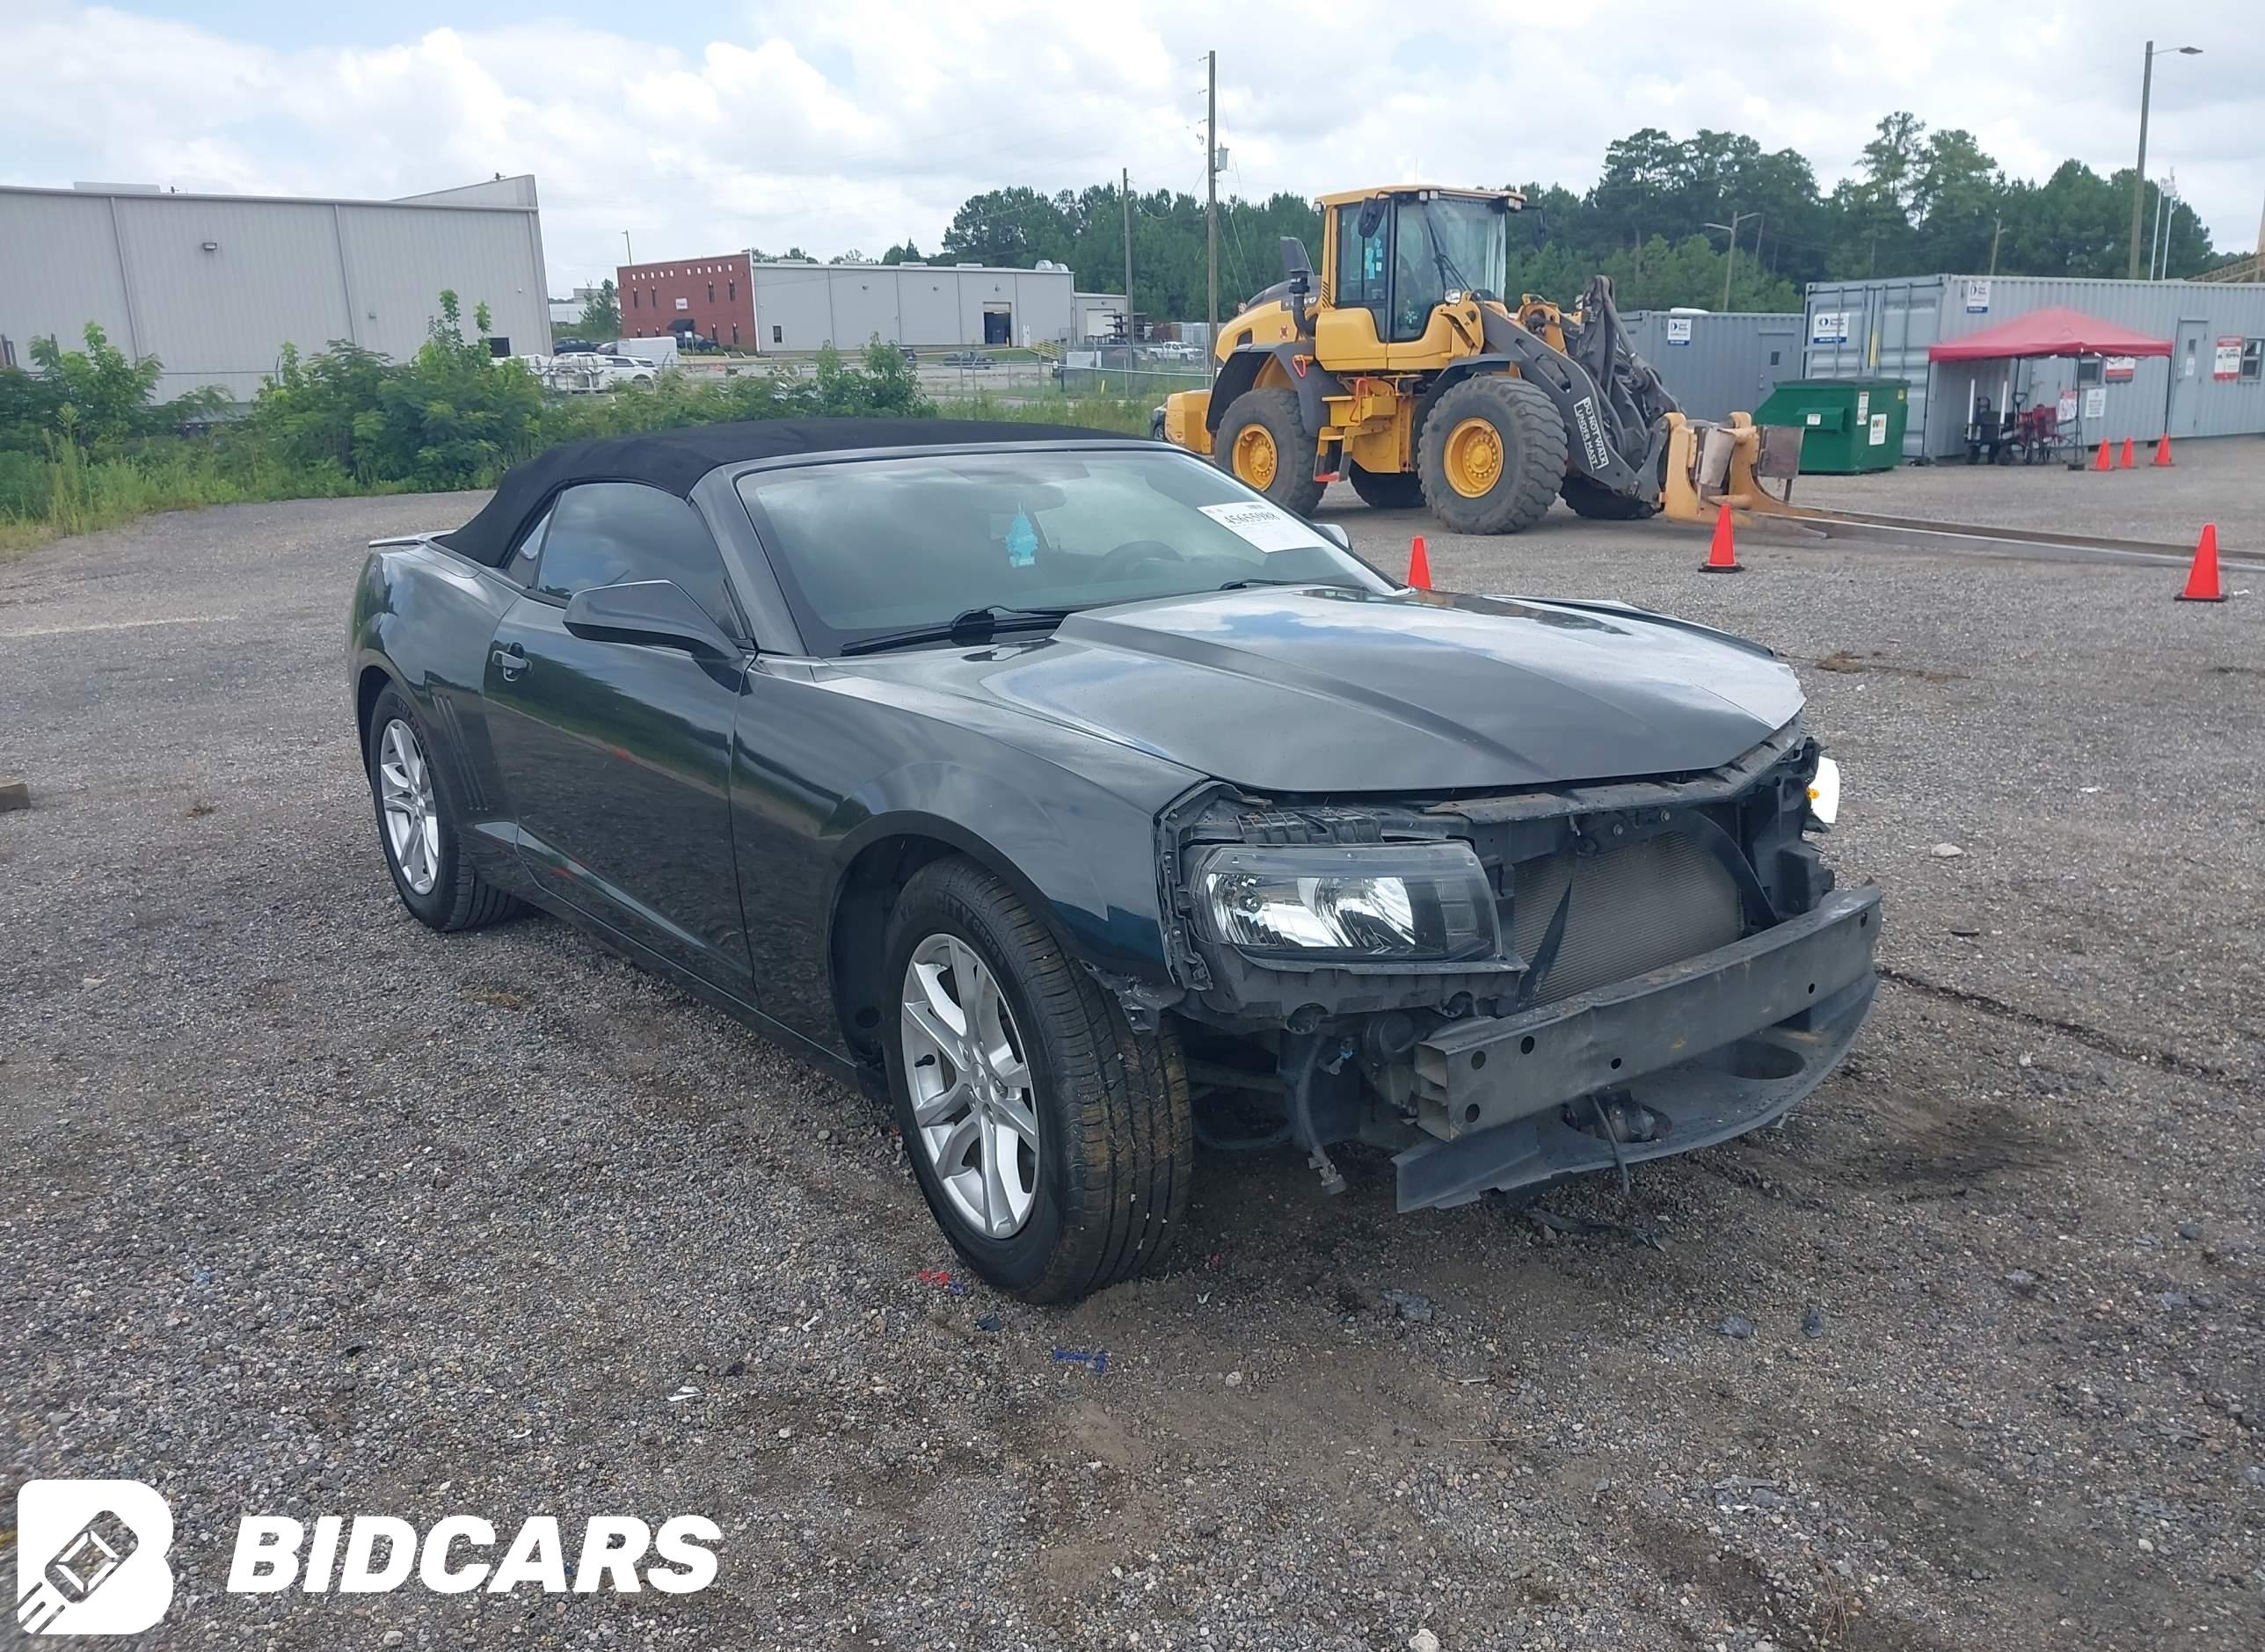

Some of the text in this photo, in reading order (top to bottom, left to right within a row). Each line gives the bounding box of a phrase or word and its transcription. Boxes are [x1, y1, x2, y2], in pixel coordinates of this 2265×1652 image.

[1577, 409, 1599, 465] UNDER MAST
[1584, 400, 1607, 465] DO NOT WALK
